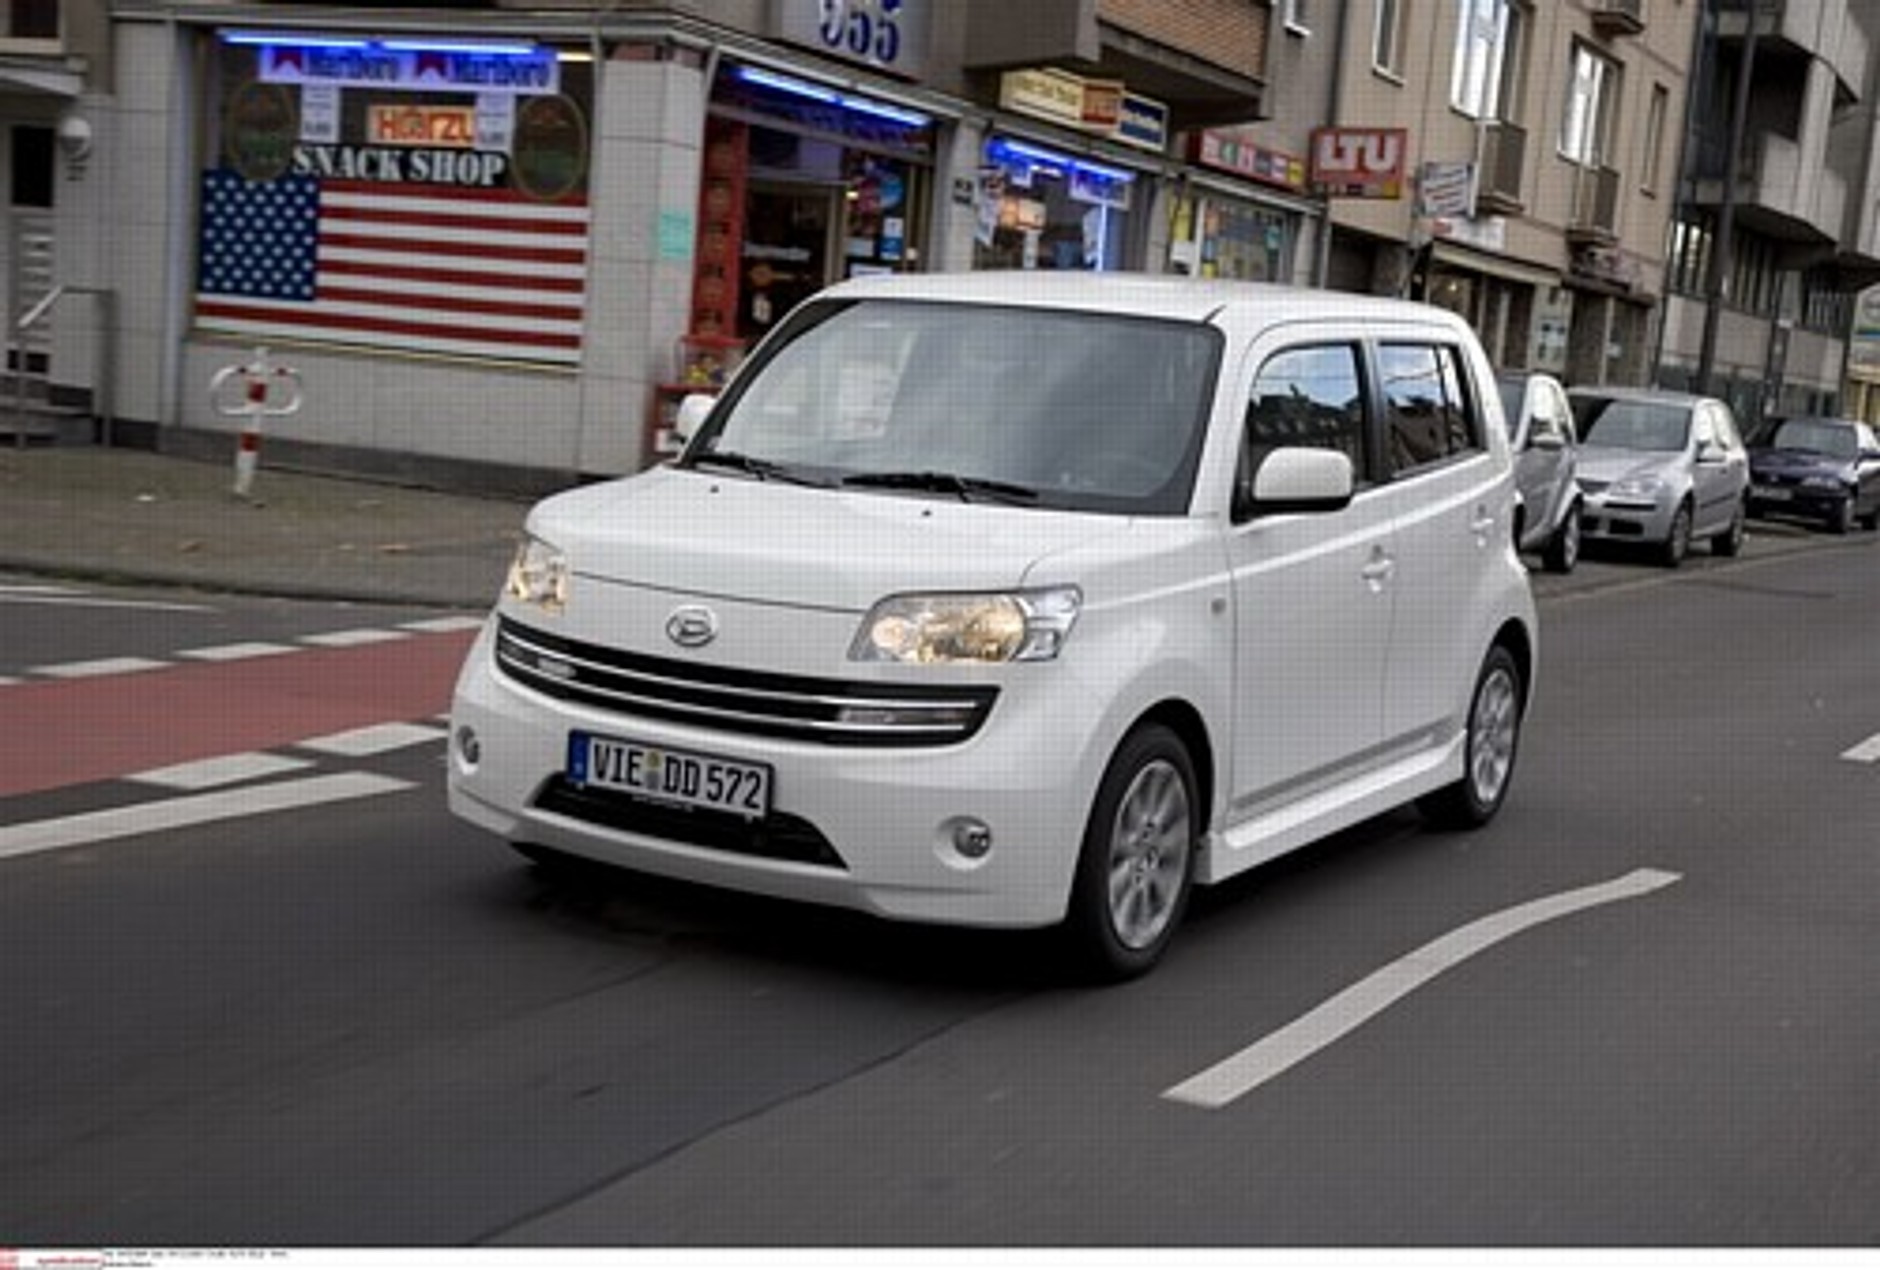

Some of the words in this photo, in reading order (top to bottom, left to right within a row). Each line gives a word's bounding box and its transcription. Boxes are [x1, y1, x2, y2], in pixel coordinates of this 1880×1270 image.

[292, 145, 404, 181] SNACK
[409, 150, 506, 187] SHOP
[1320, 135, 1398, 171] LTU
[593, 743, 644, 787] VIE
[663, 755, 701, 798] DD
[706, 763, 762, 809] 572
